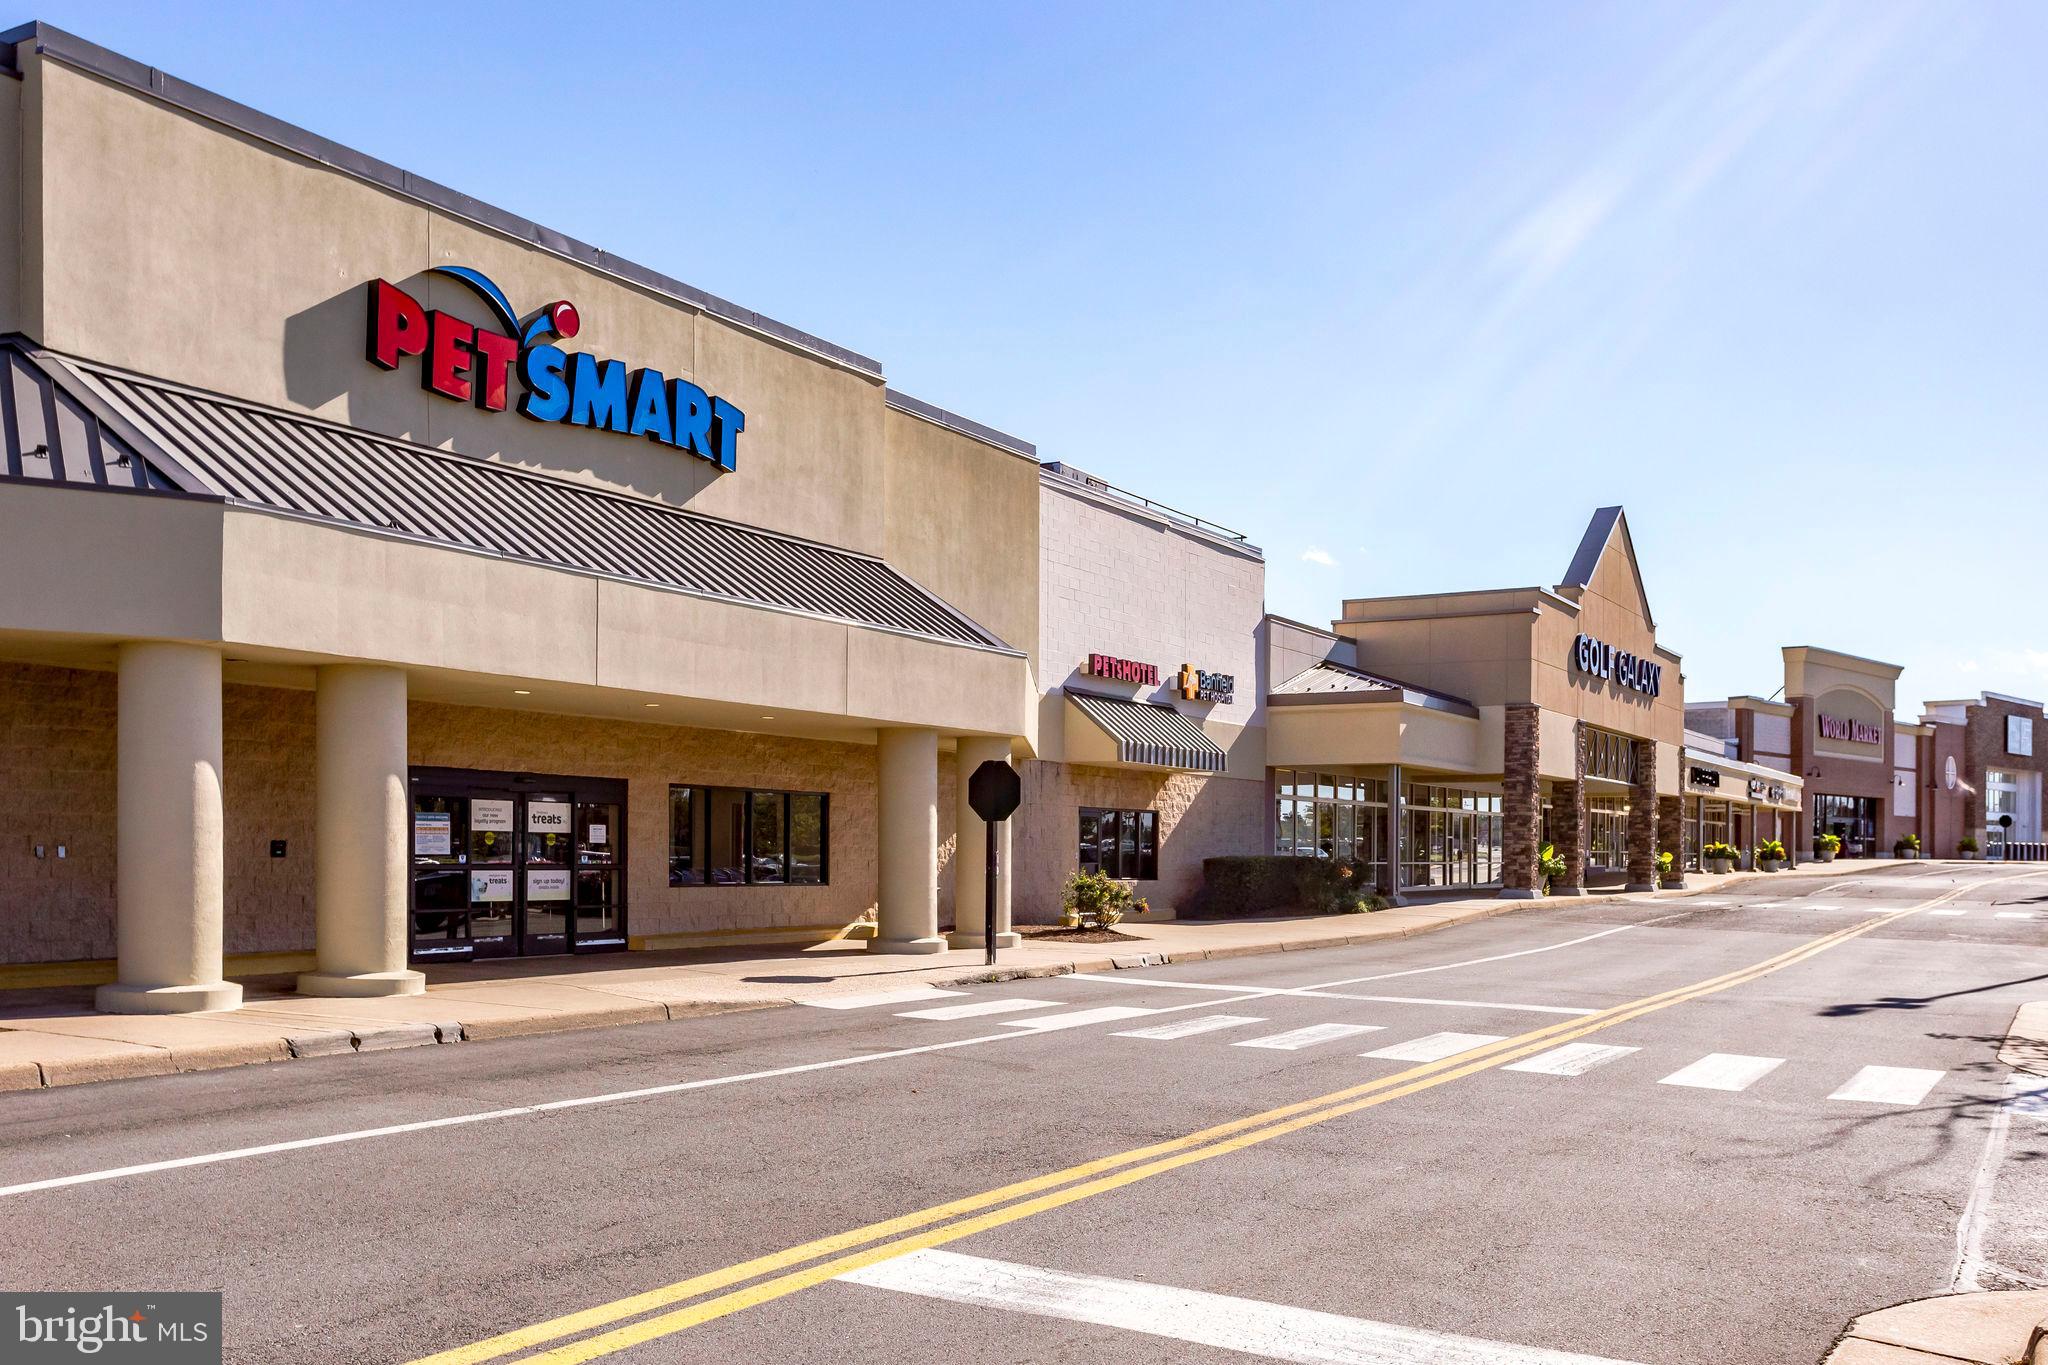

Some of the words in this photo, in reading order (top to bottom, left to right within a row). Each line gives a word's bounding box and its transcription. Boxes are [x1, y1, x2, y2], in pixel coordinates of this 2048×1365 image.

[366, 277, 745, 473] PETSMART
[1575, 632, 1615, 680] GOLF
[1615, 650, 1662, 697] GALAXY
[1197, 670, 1235, 694] Banfield
[1200, 690, 1210, 701] PET
[1819, 714, 1849, 740] WORLD
[1849, 719, 1882, 744] MARKET
[532, 814, 561, 824] treats
